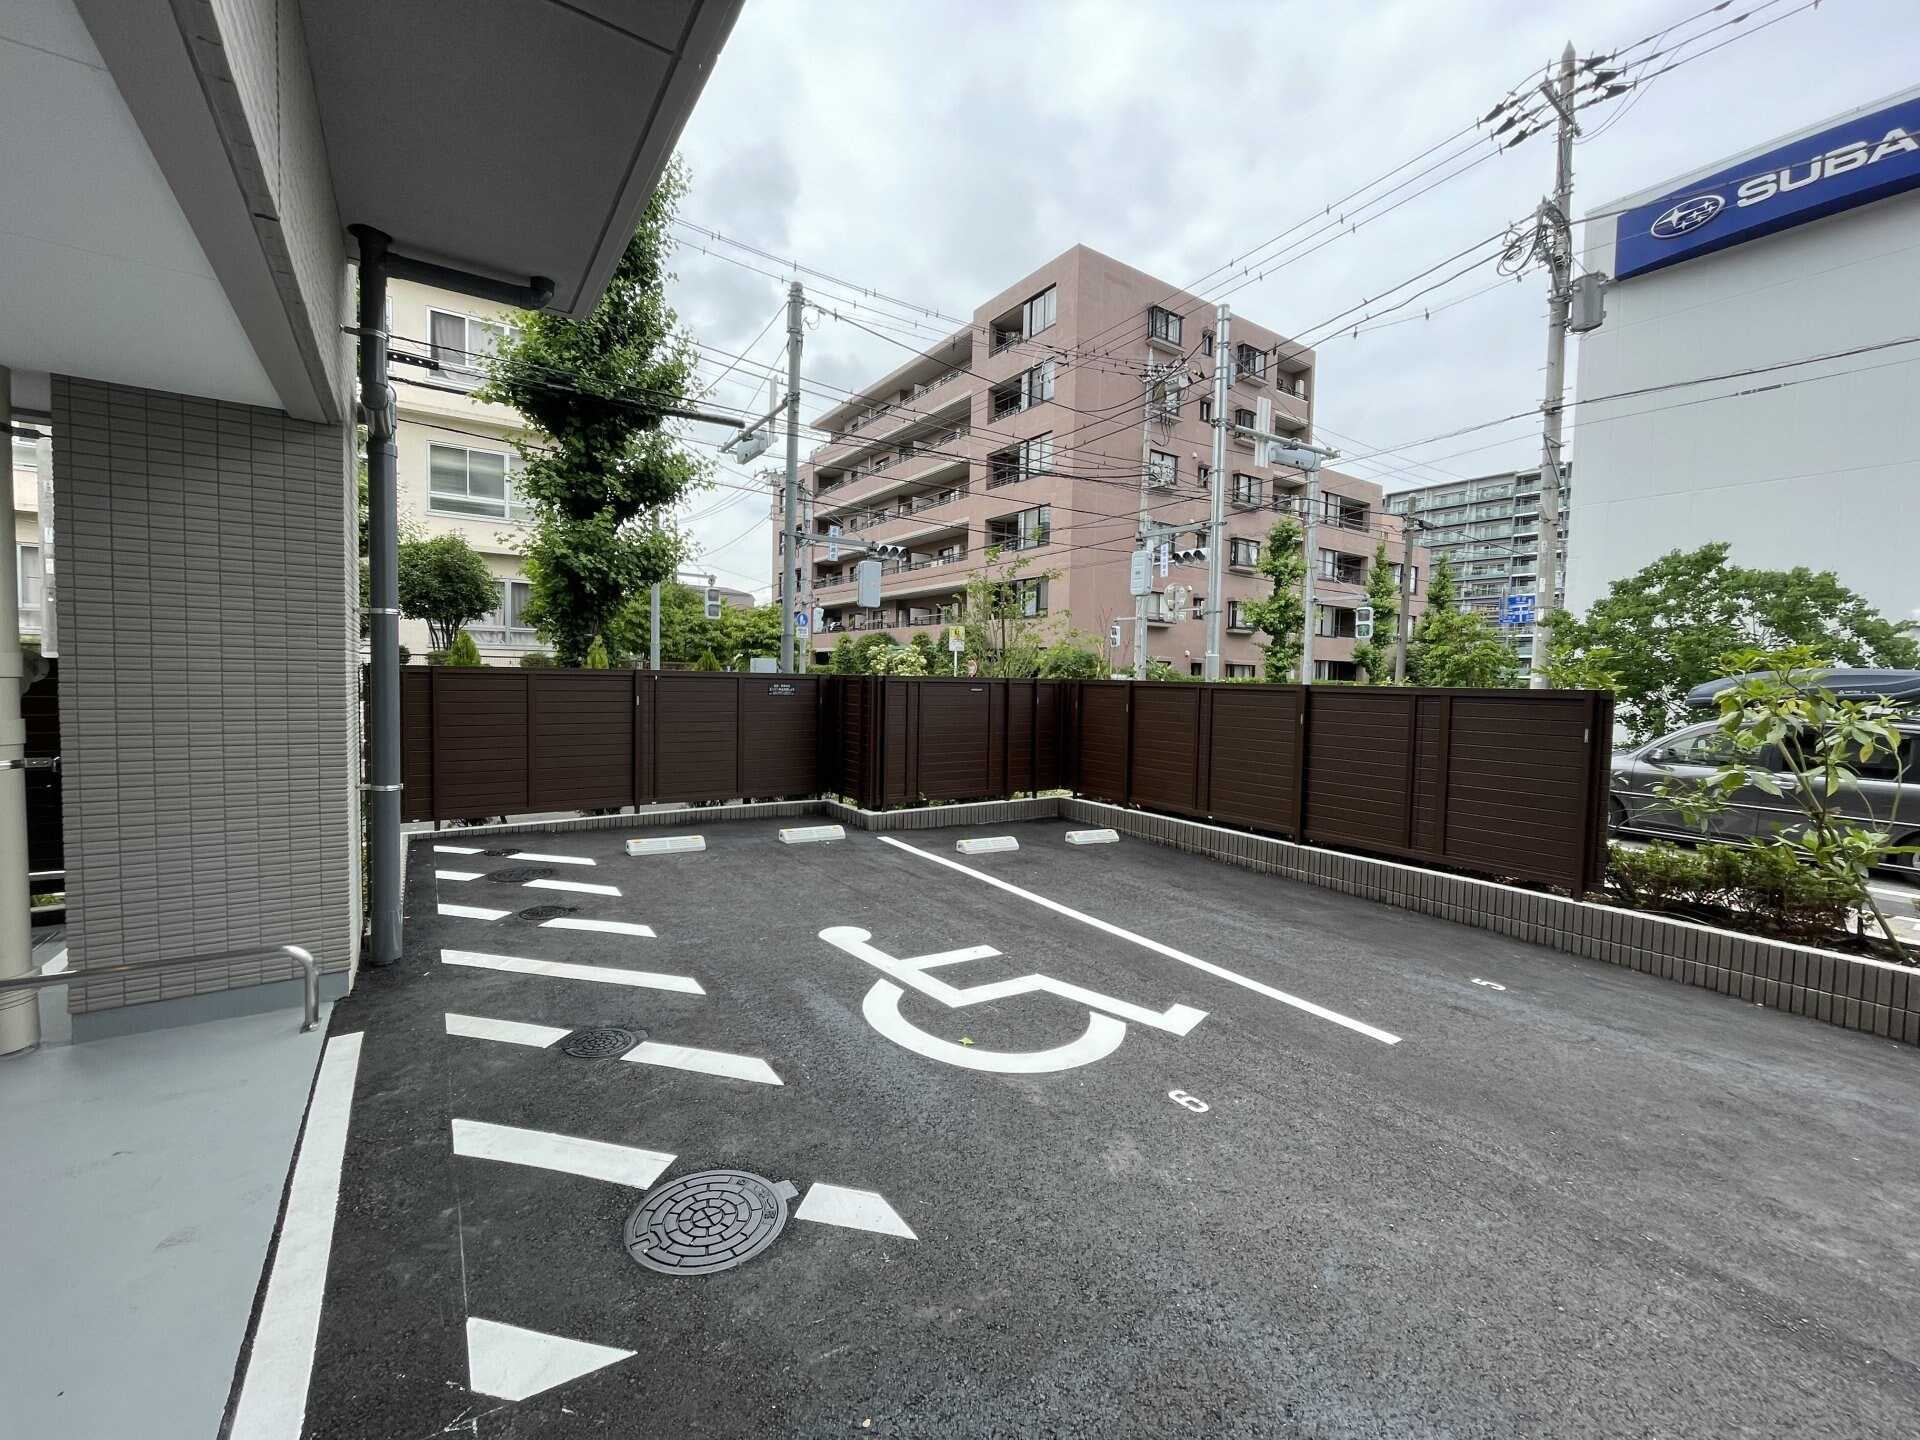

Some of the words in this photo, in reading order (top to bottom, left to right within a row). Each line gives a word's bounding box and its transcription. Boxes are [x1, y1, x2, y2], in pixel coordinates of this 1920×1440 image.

[1737, 127, 1919, 208] SUBA
[1471, 978, 1506, 990] 5
[1168, 1090, 1209, 1113] 6
